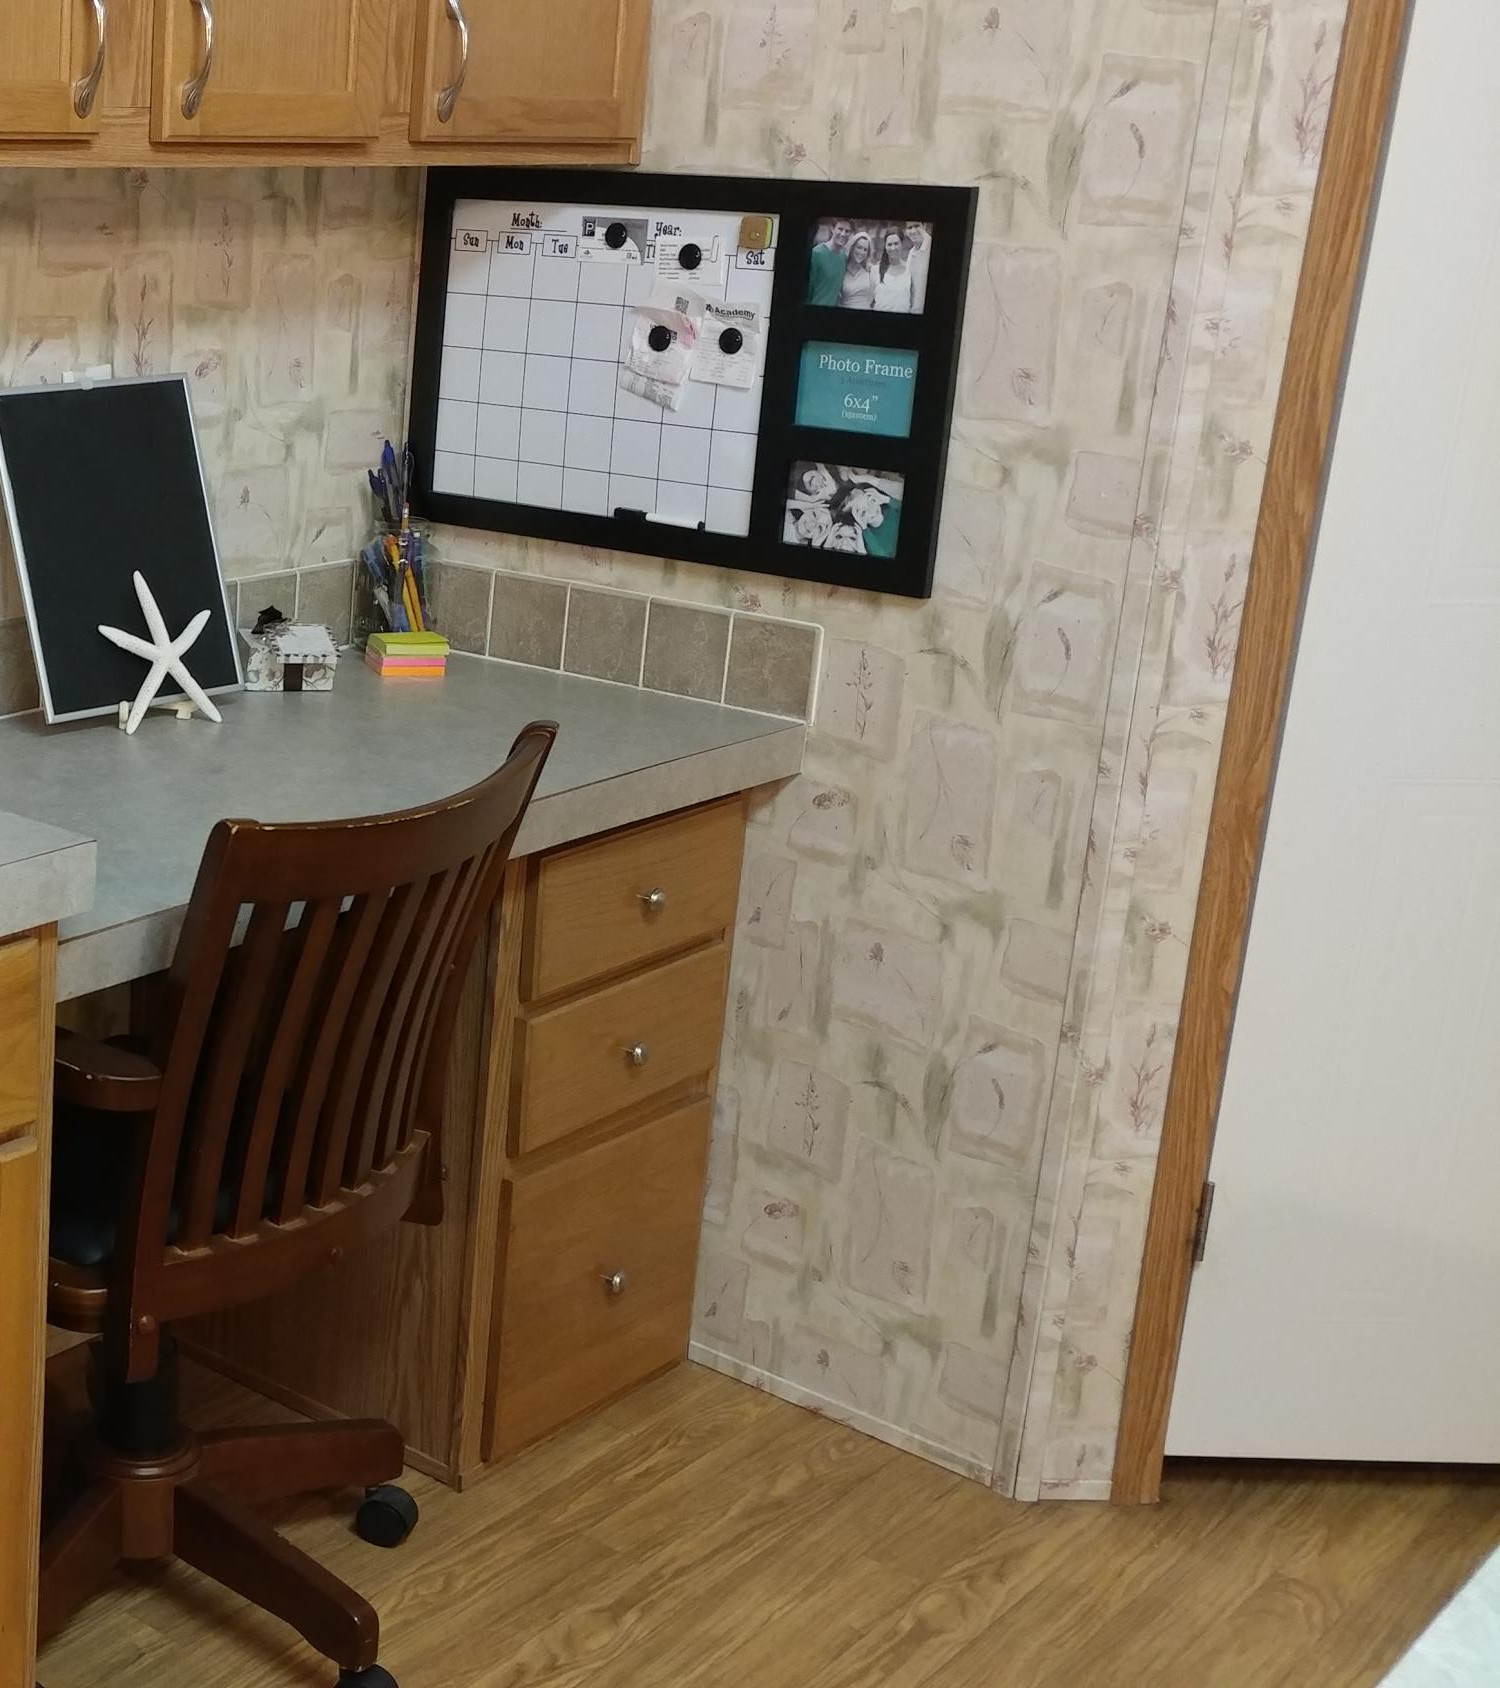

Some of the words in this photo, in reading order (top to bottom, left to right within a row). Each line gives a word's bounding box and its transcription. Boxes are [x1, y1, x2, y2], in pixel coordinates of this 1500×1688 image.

[511, 211, 543, 229] Month:
[654, 221, 683, 238] Year:
[463, 233, 480, 248] Sun
[505, 236, 524, 251] Mon
[552, 239, 569, 255] Tue
[745, 250, 766, 266] Sat
[714, 305, 757, 321] Academy
[819, 353, 861, 373] Photo
[864, 359, 914, 379] Frame
